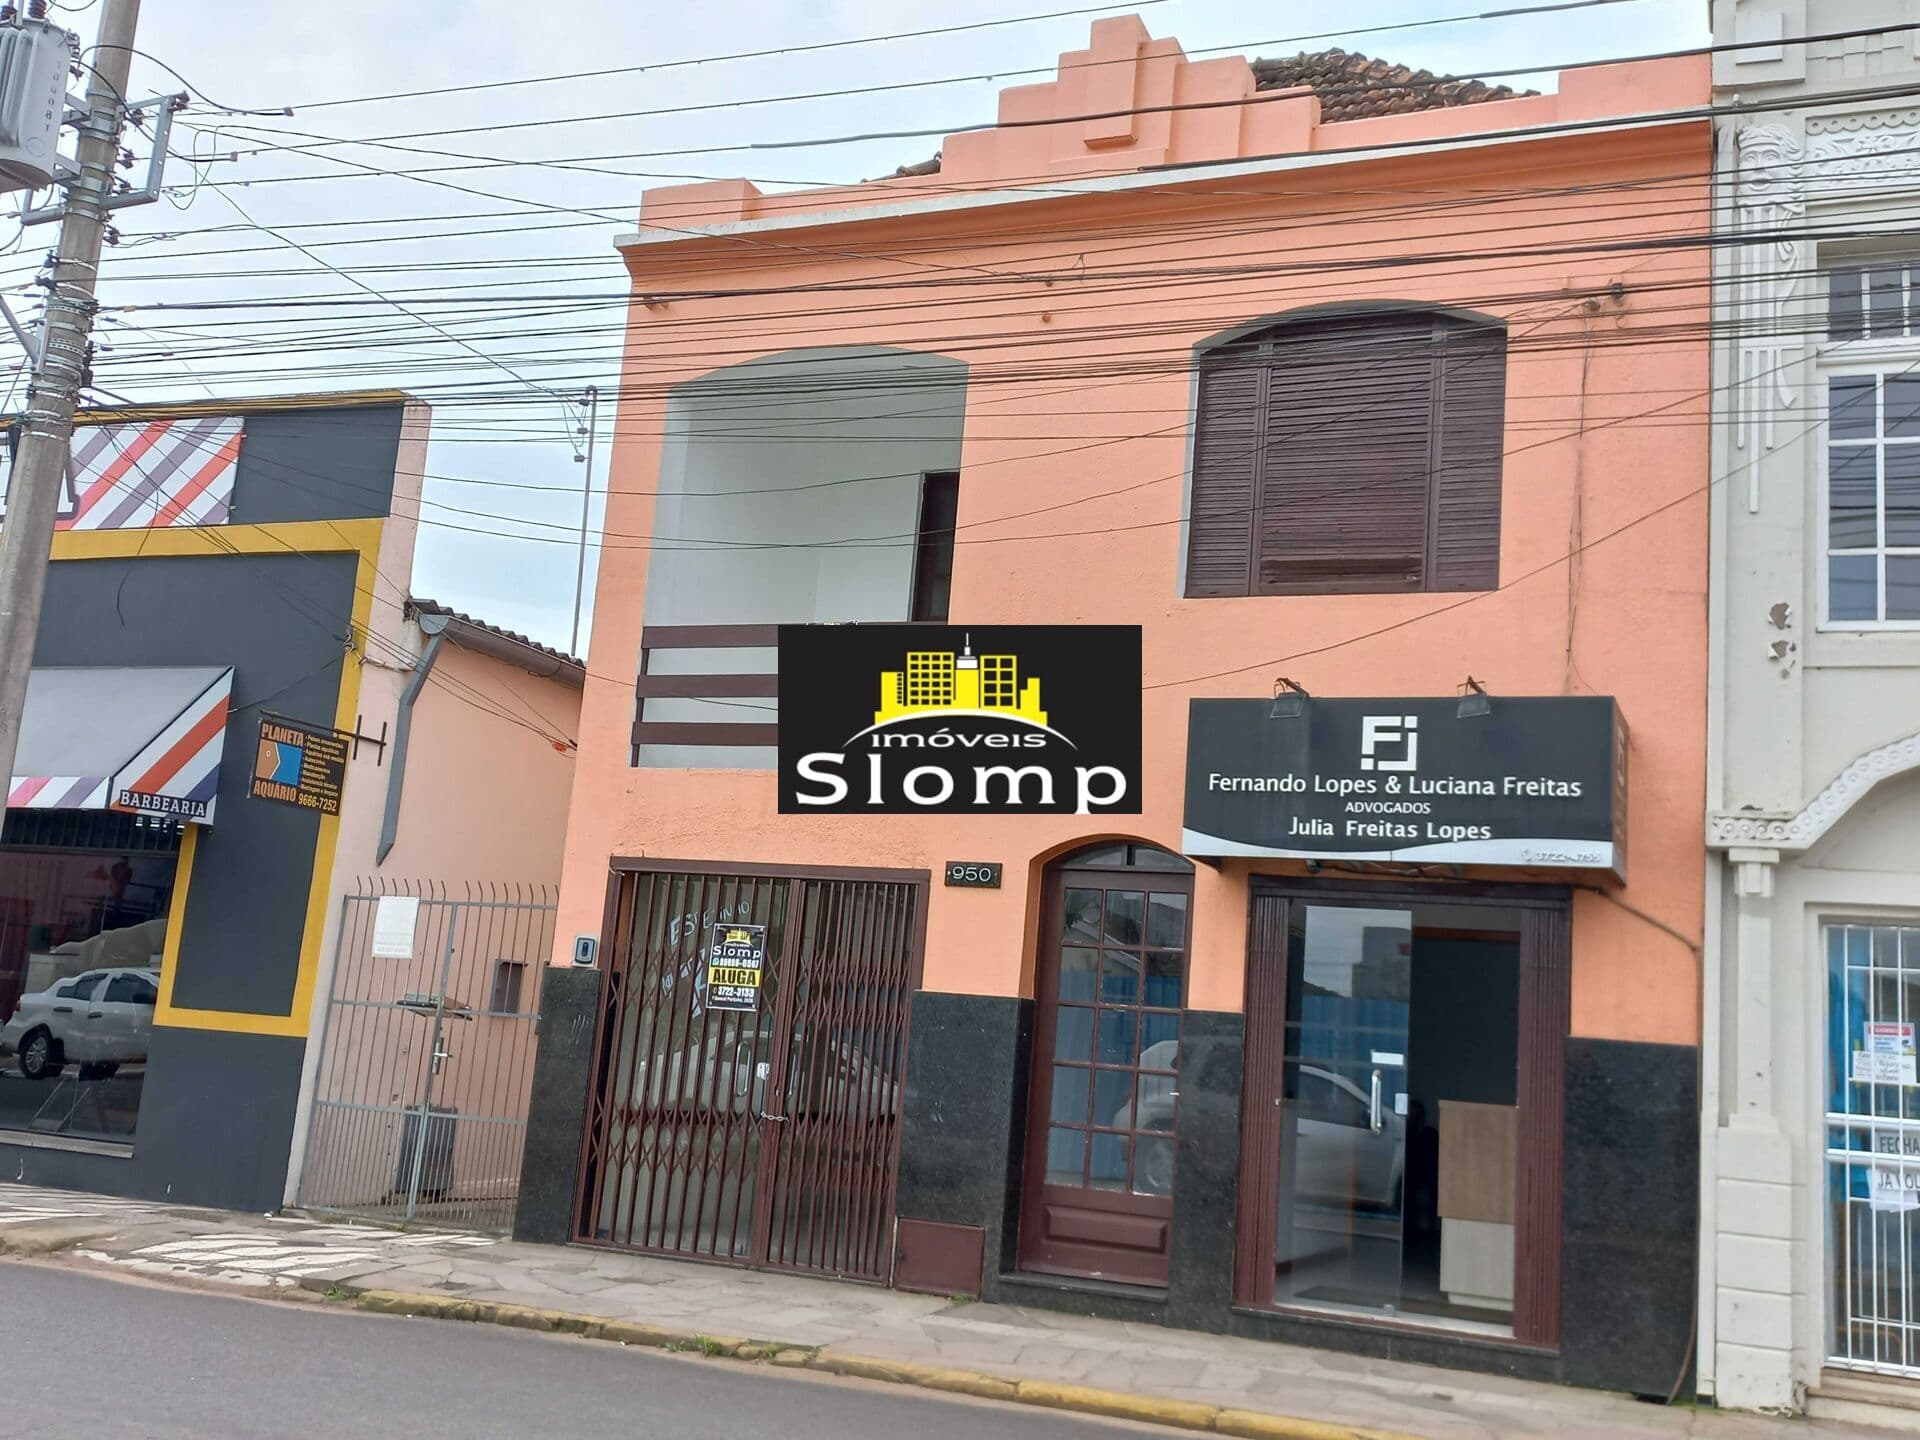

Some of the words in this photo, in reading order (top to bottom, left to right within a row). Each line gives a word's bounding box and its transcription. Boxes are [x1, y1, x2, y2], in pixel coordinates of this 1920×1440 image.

[261, 723, 304, 747] PLANETA
[253, 780, 297, 802] AQUÁRIO
[1208, 773, 1307, 794] Fernando
[1314, 775, 1377, 799] Lopes
[1385, 777, 1402, 794] &
[1409, 776, 1495, 796] Luciana
[1503, 776, 1582, 797] Freitas
[120, 791, 206, 817] BARBEARIA
[298, 793, 337, 811] 9666-7252
[1344, 802, 1431, 814] ADVOGADOS
[1288, 817, 1334, 836] Julia
[1345, 820, 1418, 839] Freitas
[1427, 822, 1491, 842] Lopes
[952, 866, 991, 881] 950
[713, 945, 761, 959] Slomp
[712, 969, 757, 985] ALUGA
